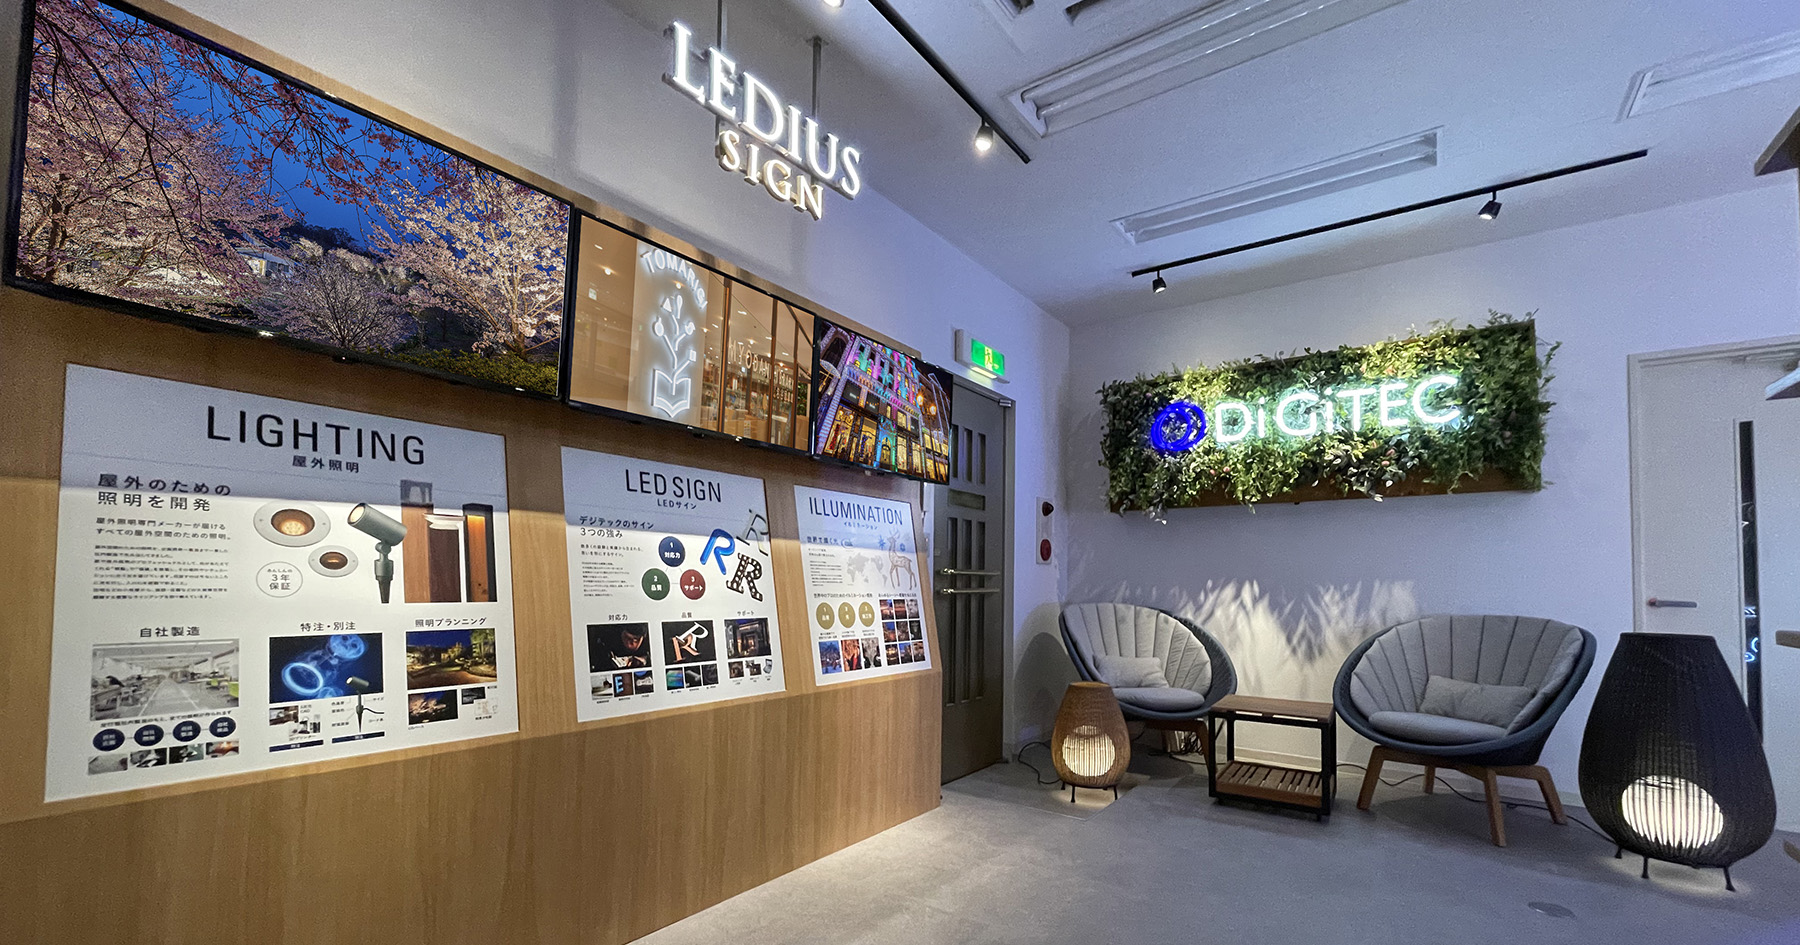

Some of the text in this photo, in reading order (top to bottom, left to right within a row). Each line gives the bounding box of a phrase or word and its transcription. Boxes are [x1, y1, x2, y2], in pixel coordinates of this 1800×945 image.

[672, 20, 862, 198] LEDIUS
[718, 129, 824, 220] SIGN
[207, 405, 425, 466] LIGHTING
[292, 455, 360, 474] 屋外照明
[98, 474, 231, 496] 屋外のための
[625, 468, 722, 503] LED SIGN
[98, 491, 211, 512] 照明を開発
[657, 499, 697, 510] LEDサイン
[809, 496, 903, 526] ILLUMINATION
[580, 515, 654, 530] デジテックのサイン
[580, 527, 623, 538] 3つの強み
[140, 626, 201, 638] 自社製造
[300, 621, 356, 632] 特注・別注
[415, 617, 488, 628] 照明プランニング
